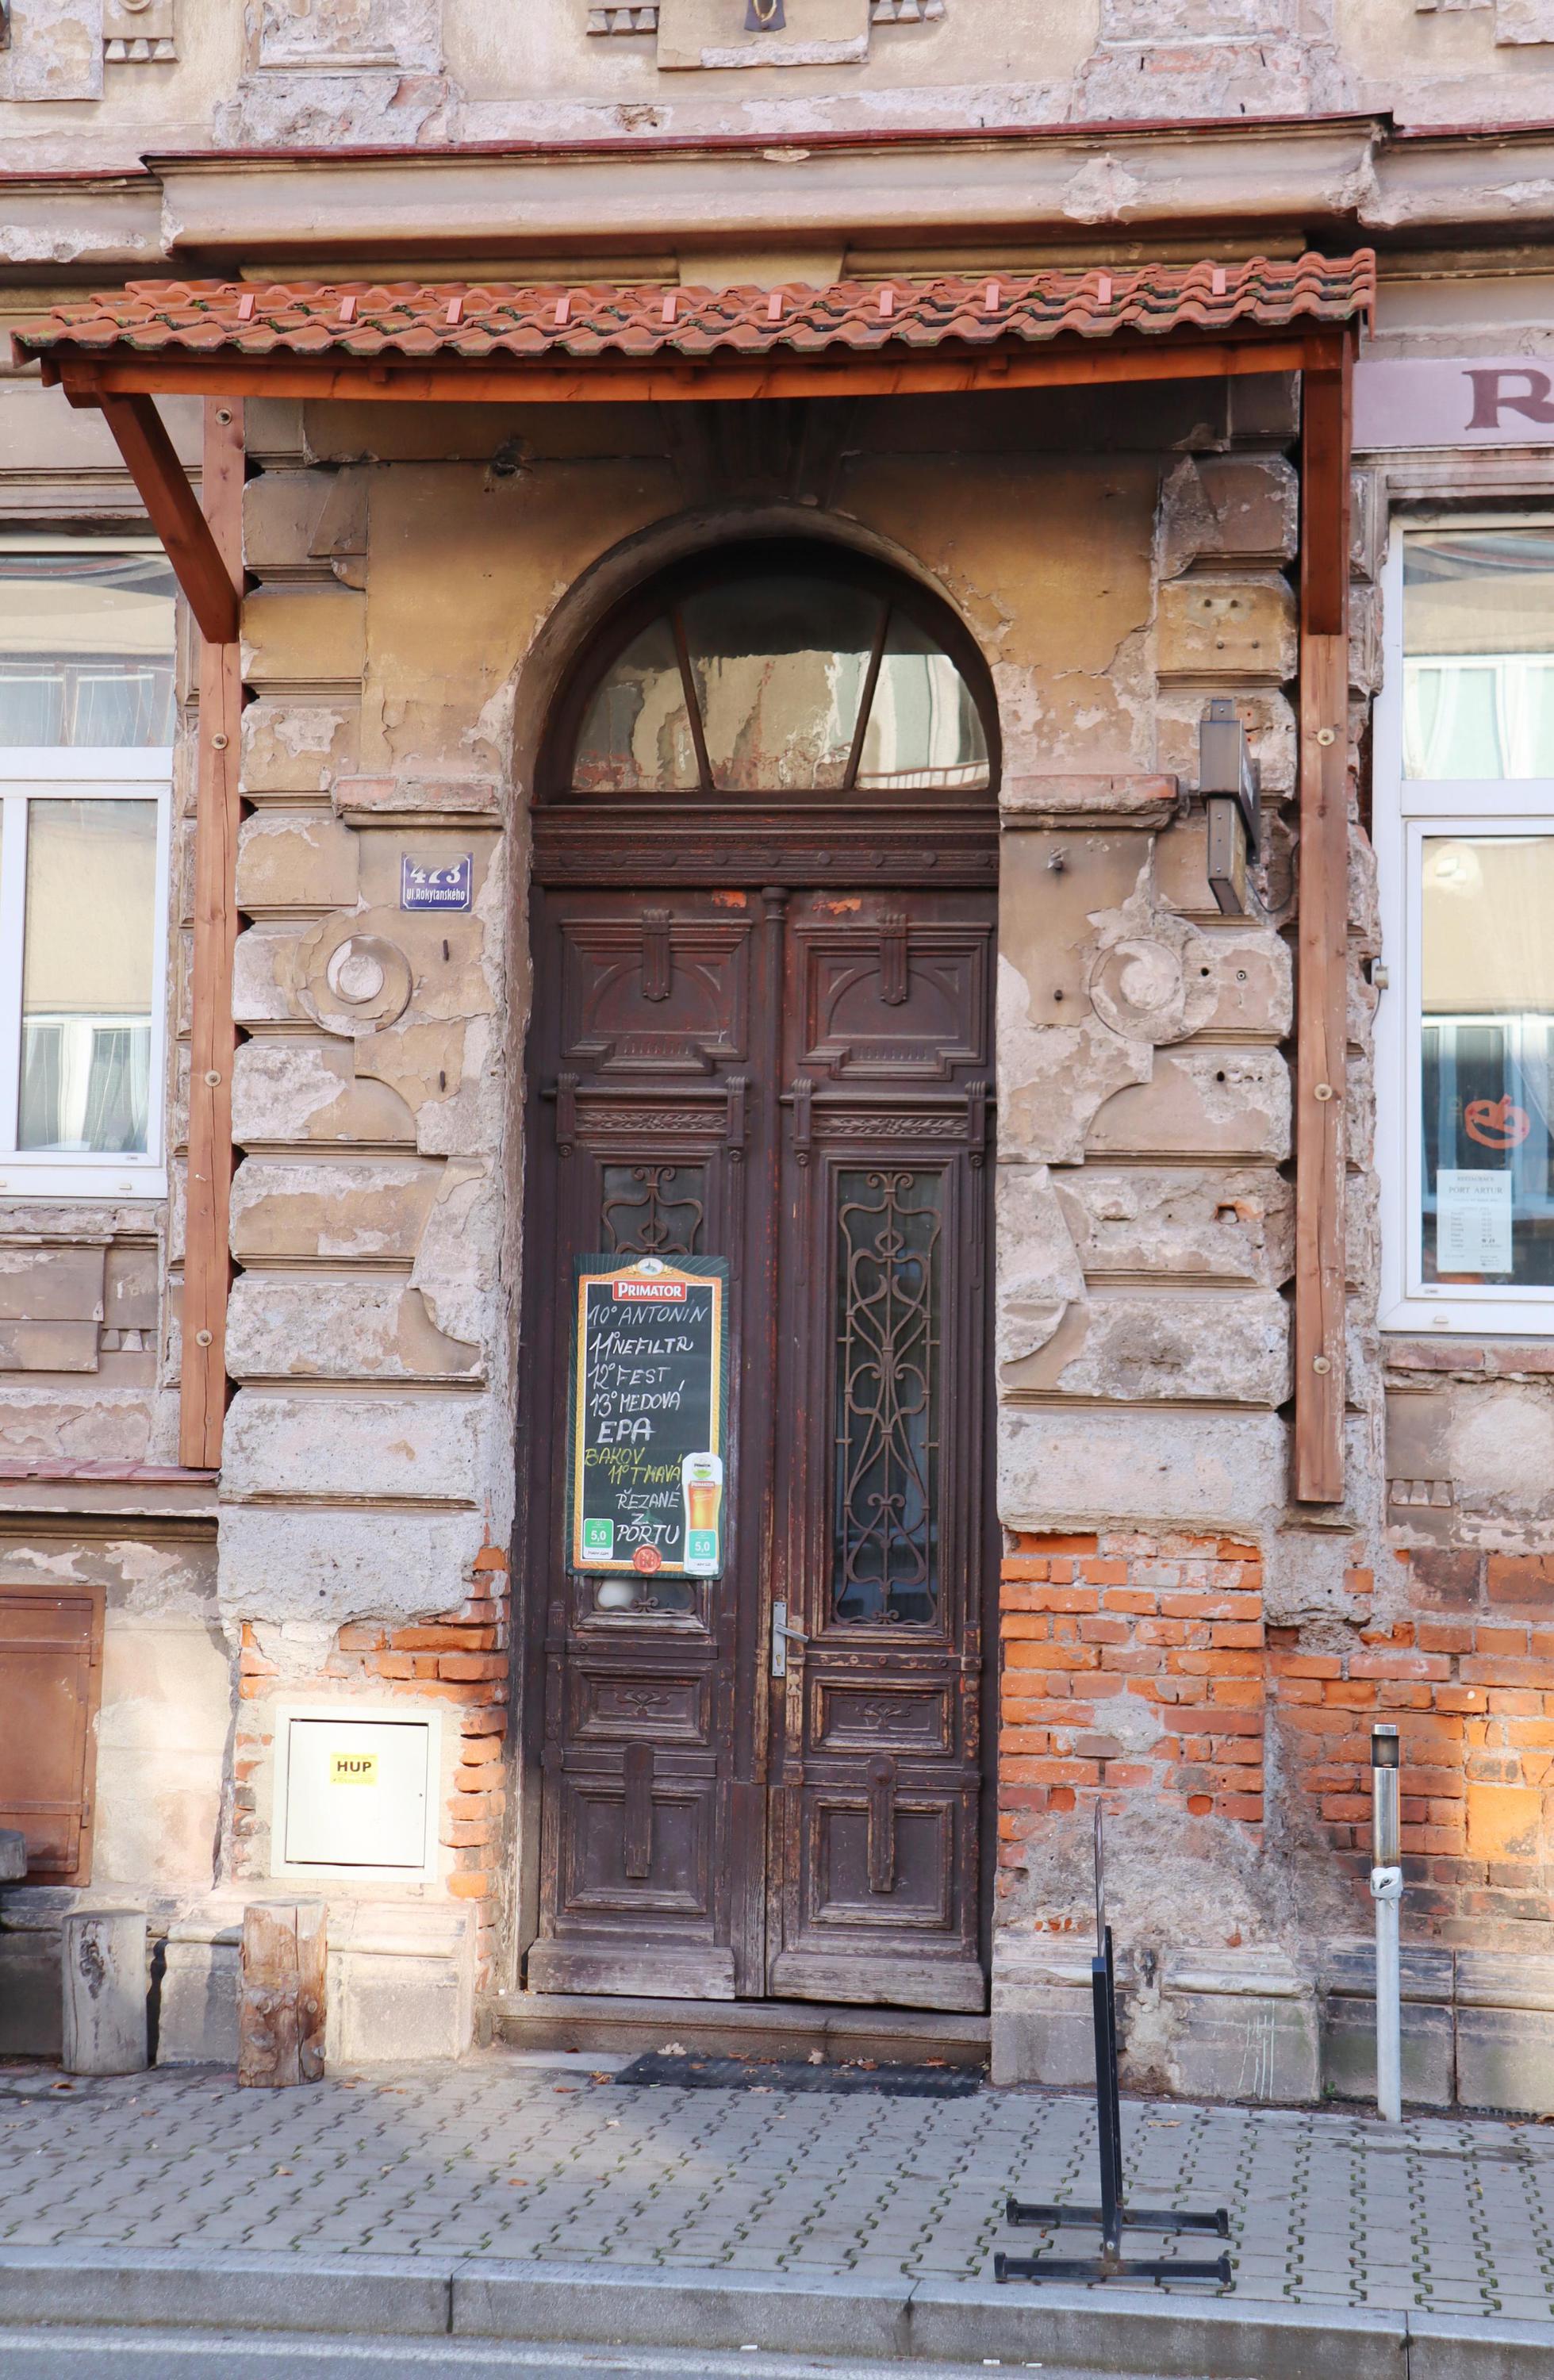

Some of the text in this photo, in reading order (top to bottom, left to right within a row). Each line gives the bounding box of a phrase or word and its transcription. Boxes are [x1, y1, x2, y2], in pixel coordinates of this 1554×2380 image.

[410, 863, 460, 884] 473
[616, 1365, 671, 1386] FEST
[597, 1417, 655, 1444] EPA
[616, 1484, 681, 1510] ŘEZANÉ
[616, 1524, 680, 1545] PORTU
[337, 1760, 372, 1772] HUP
